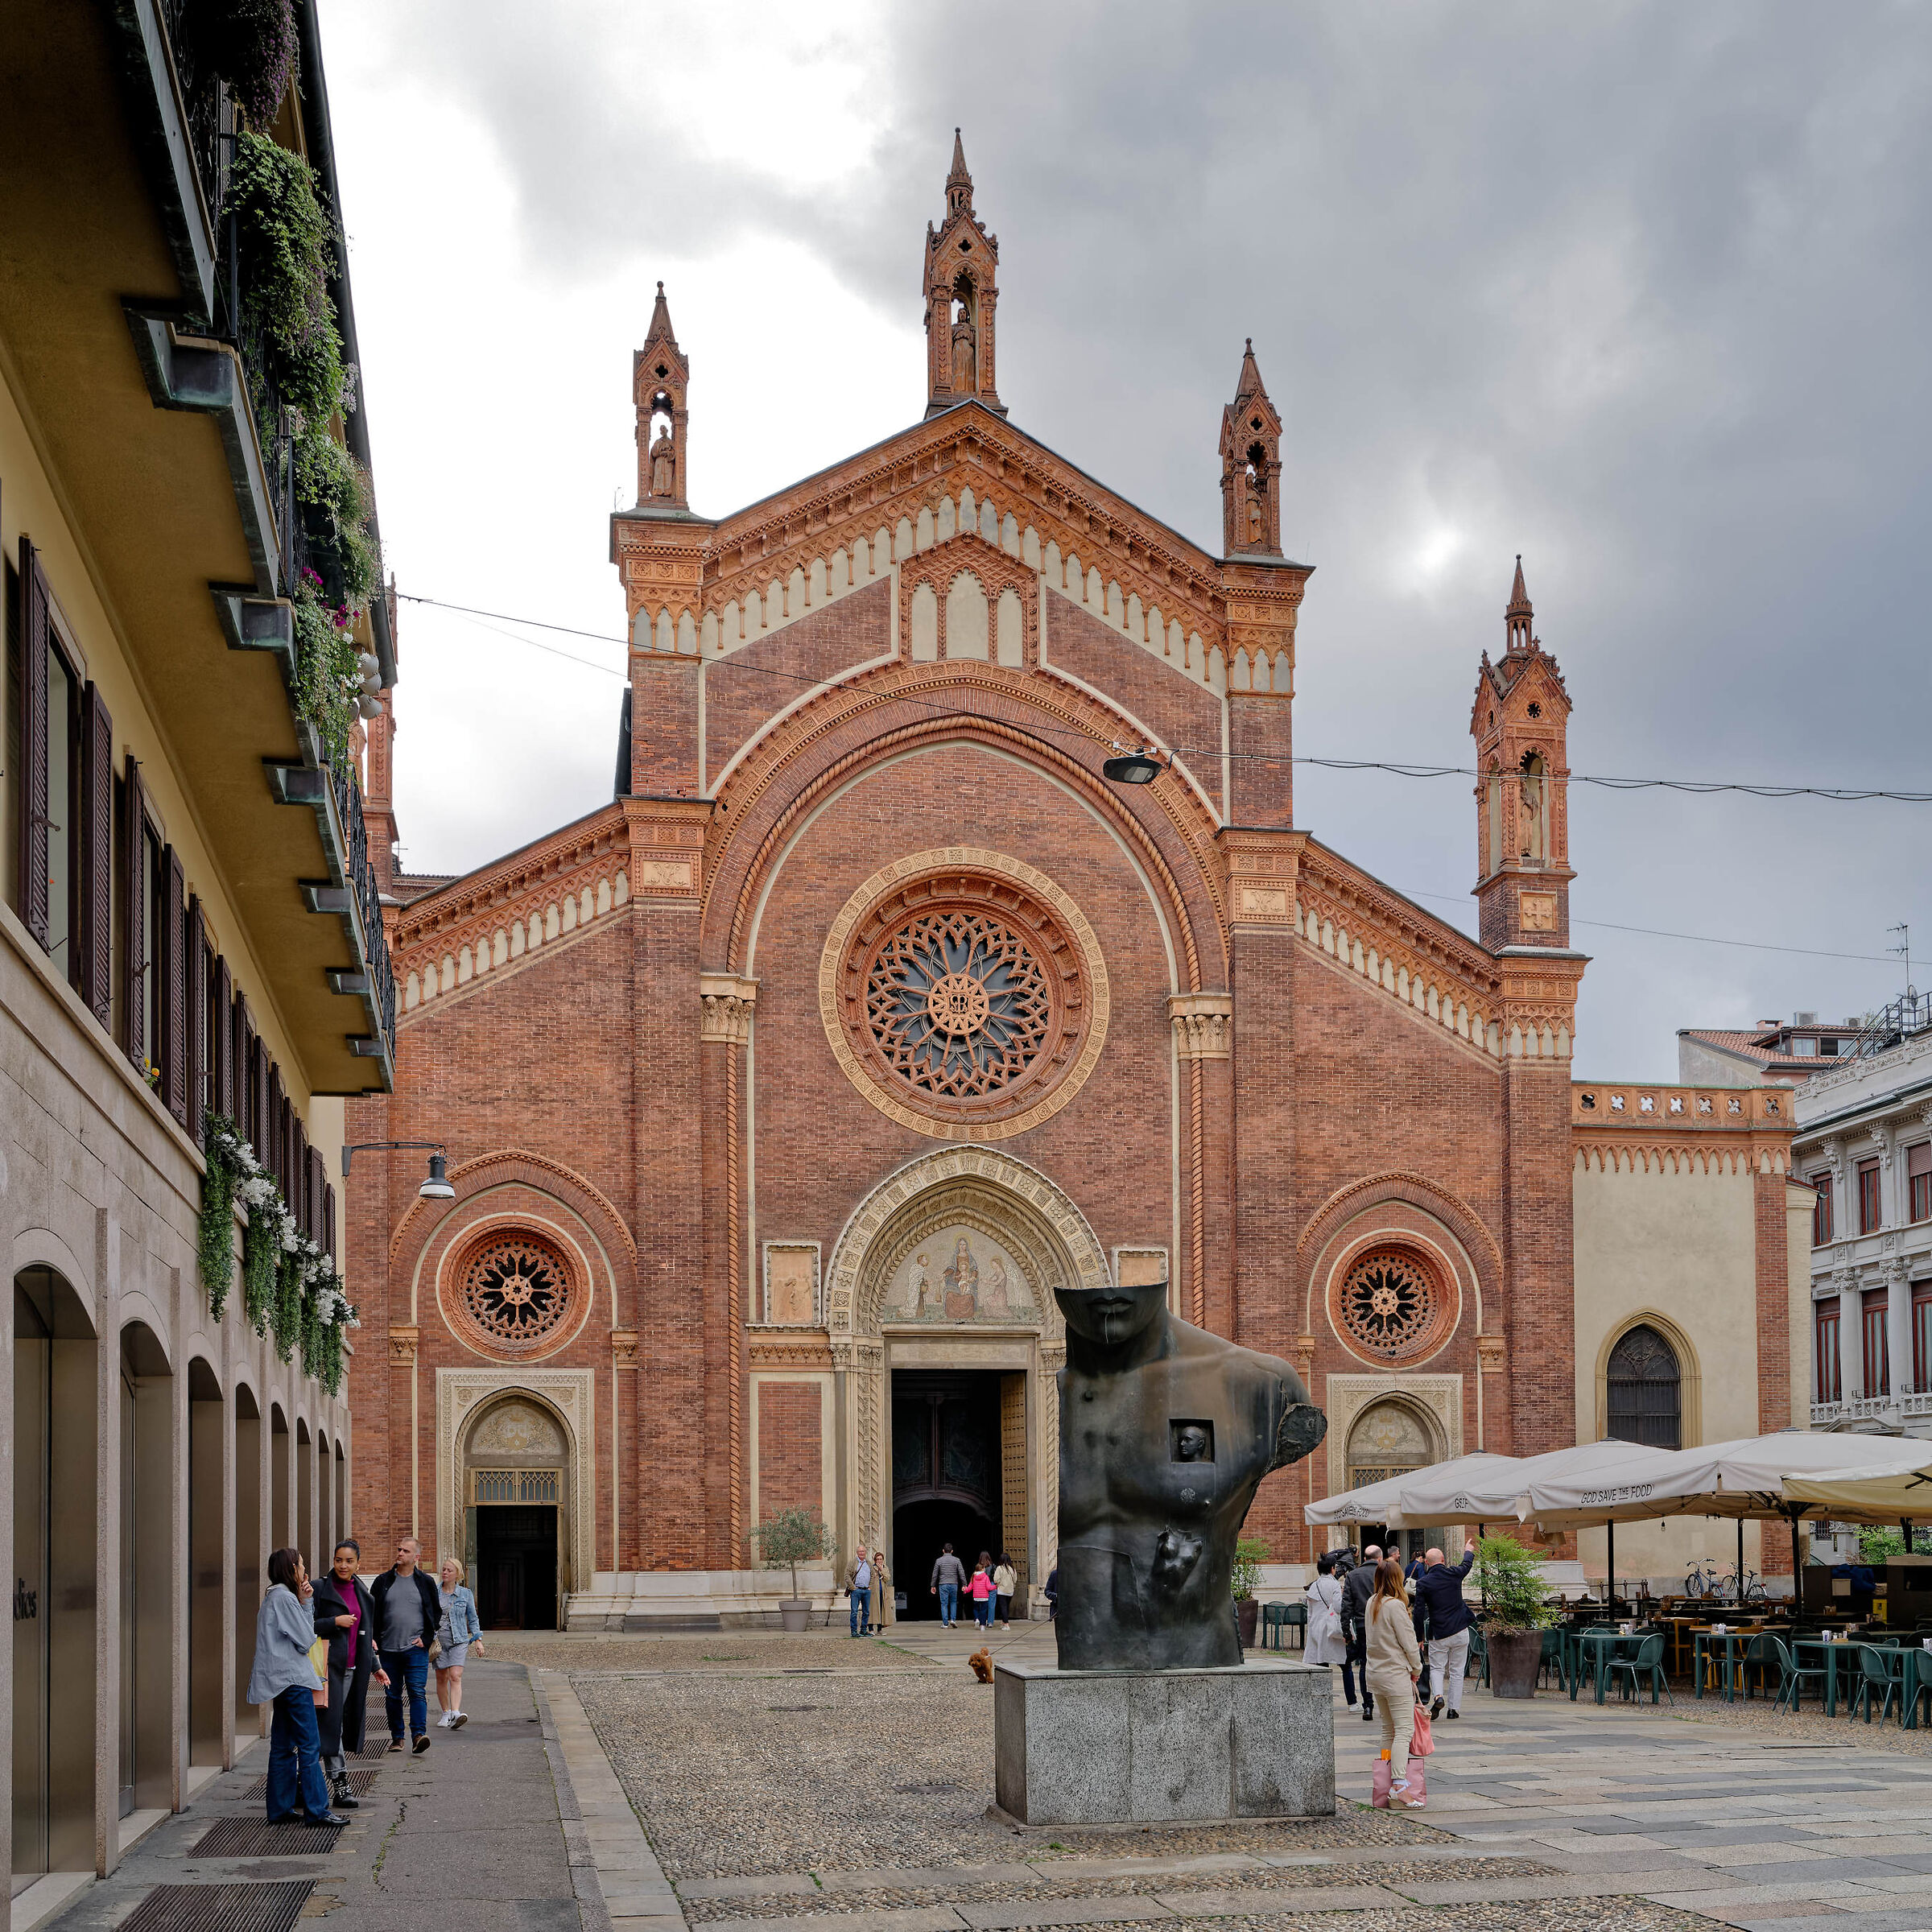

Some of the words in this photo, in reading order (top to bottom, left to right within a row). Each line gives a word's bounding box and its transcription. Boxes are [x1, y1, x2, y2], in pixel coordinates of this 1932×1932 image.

[1581, 1492, 1597, 1504] GOD
[1598, 1488, 1616, 1502] SAVE
[1619, 1488, 1629, 1496] THE
[1630, 1484, 1653, 1498] FOOD
